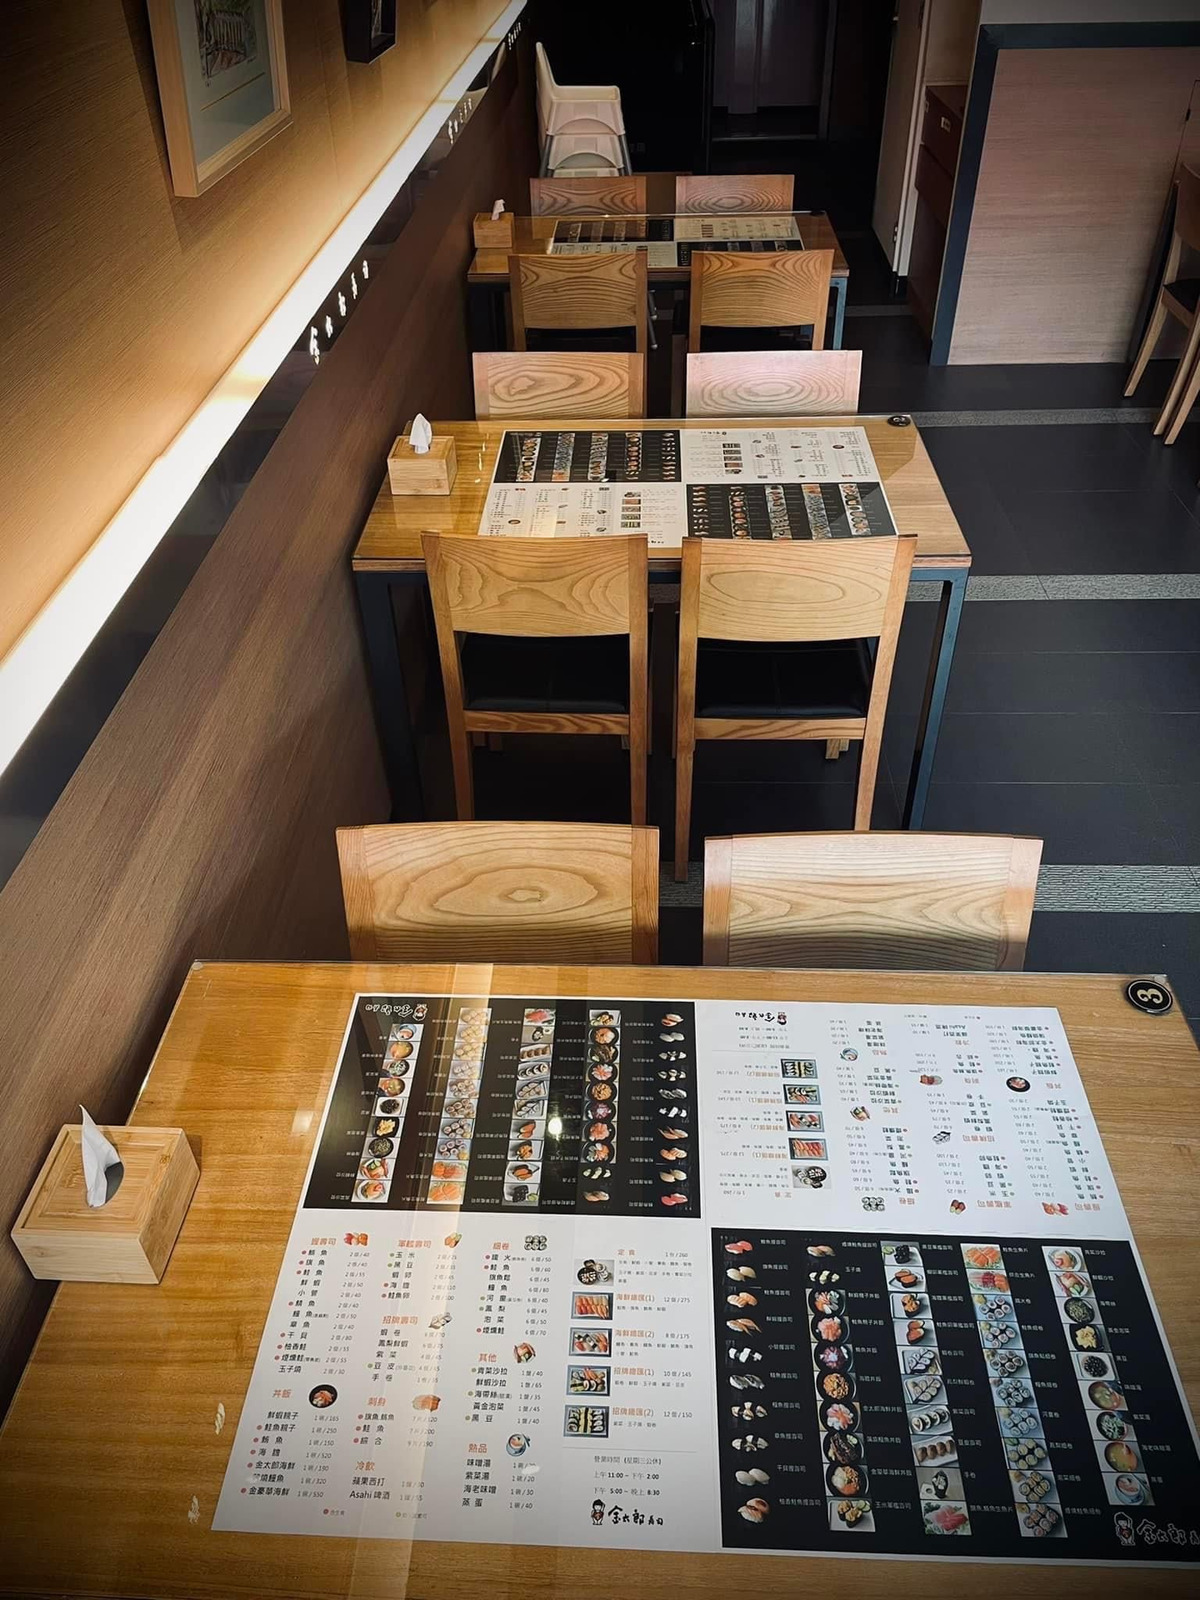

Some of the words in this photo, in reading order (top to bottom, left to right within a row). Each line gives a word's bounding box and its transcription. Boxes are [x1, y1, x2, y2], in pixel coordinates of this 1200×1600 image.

[1136, 988, 1163, 1004] 3
[479, 1353, 497, 1362] 其他
[349, 1490, 372, 1499] Asahi
